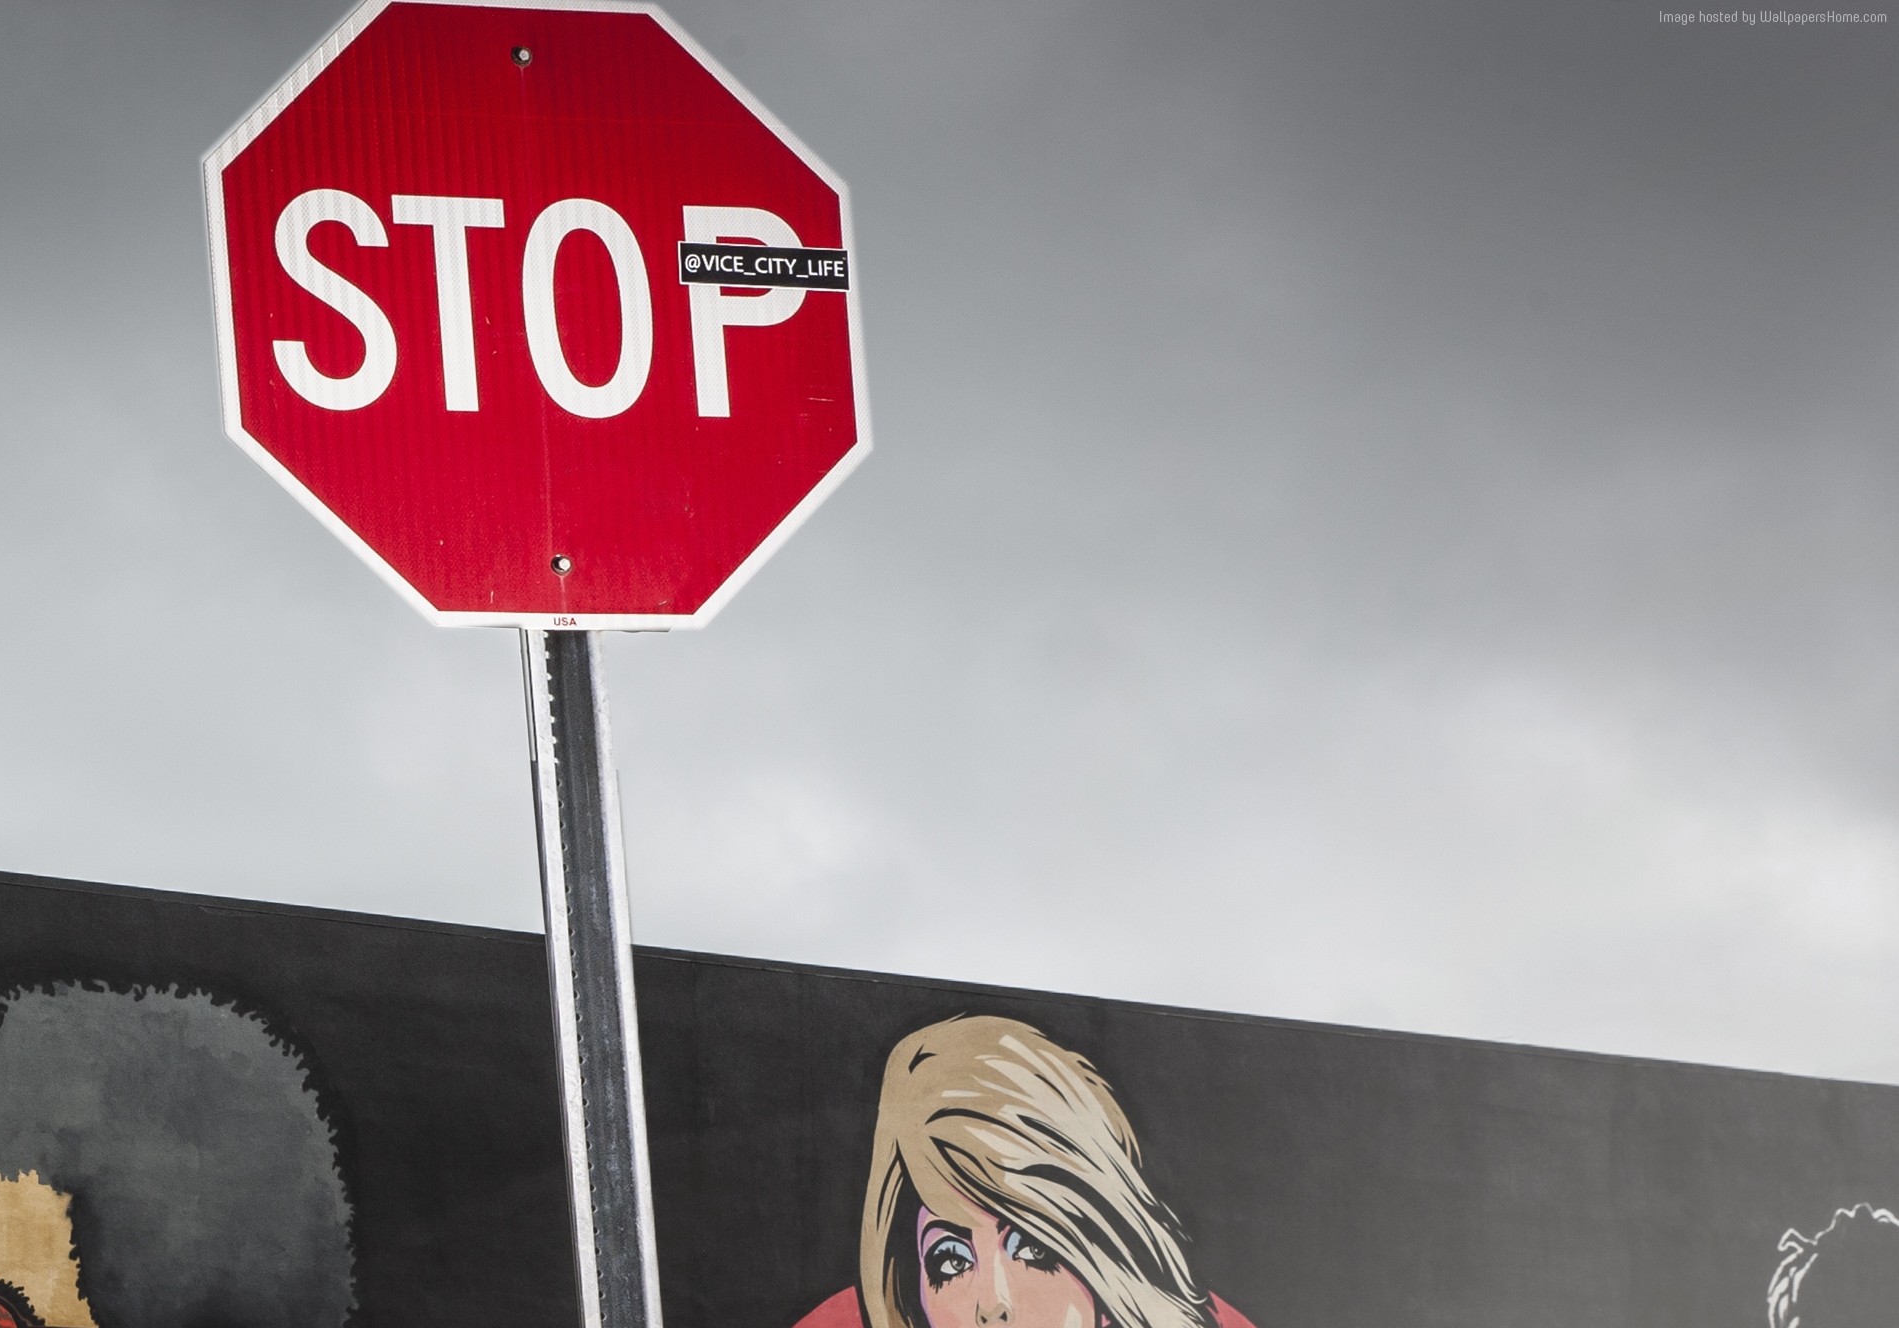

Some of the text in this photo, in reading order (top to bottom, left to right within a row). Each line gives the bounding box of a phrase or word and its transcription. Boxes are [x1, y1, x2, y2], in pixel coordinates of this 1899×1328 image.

[684, 254, 845, 278] @VICE_CITY_LIFE
[272, 188, 806, 419] STOP
[553, 617, 576, 626] USA
